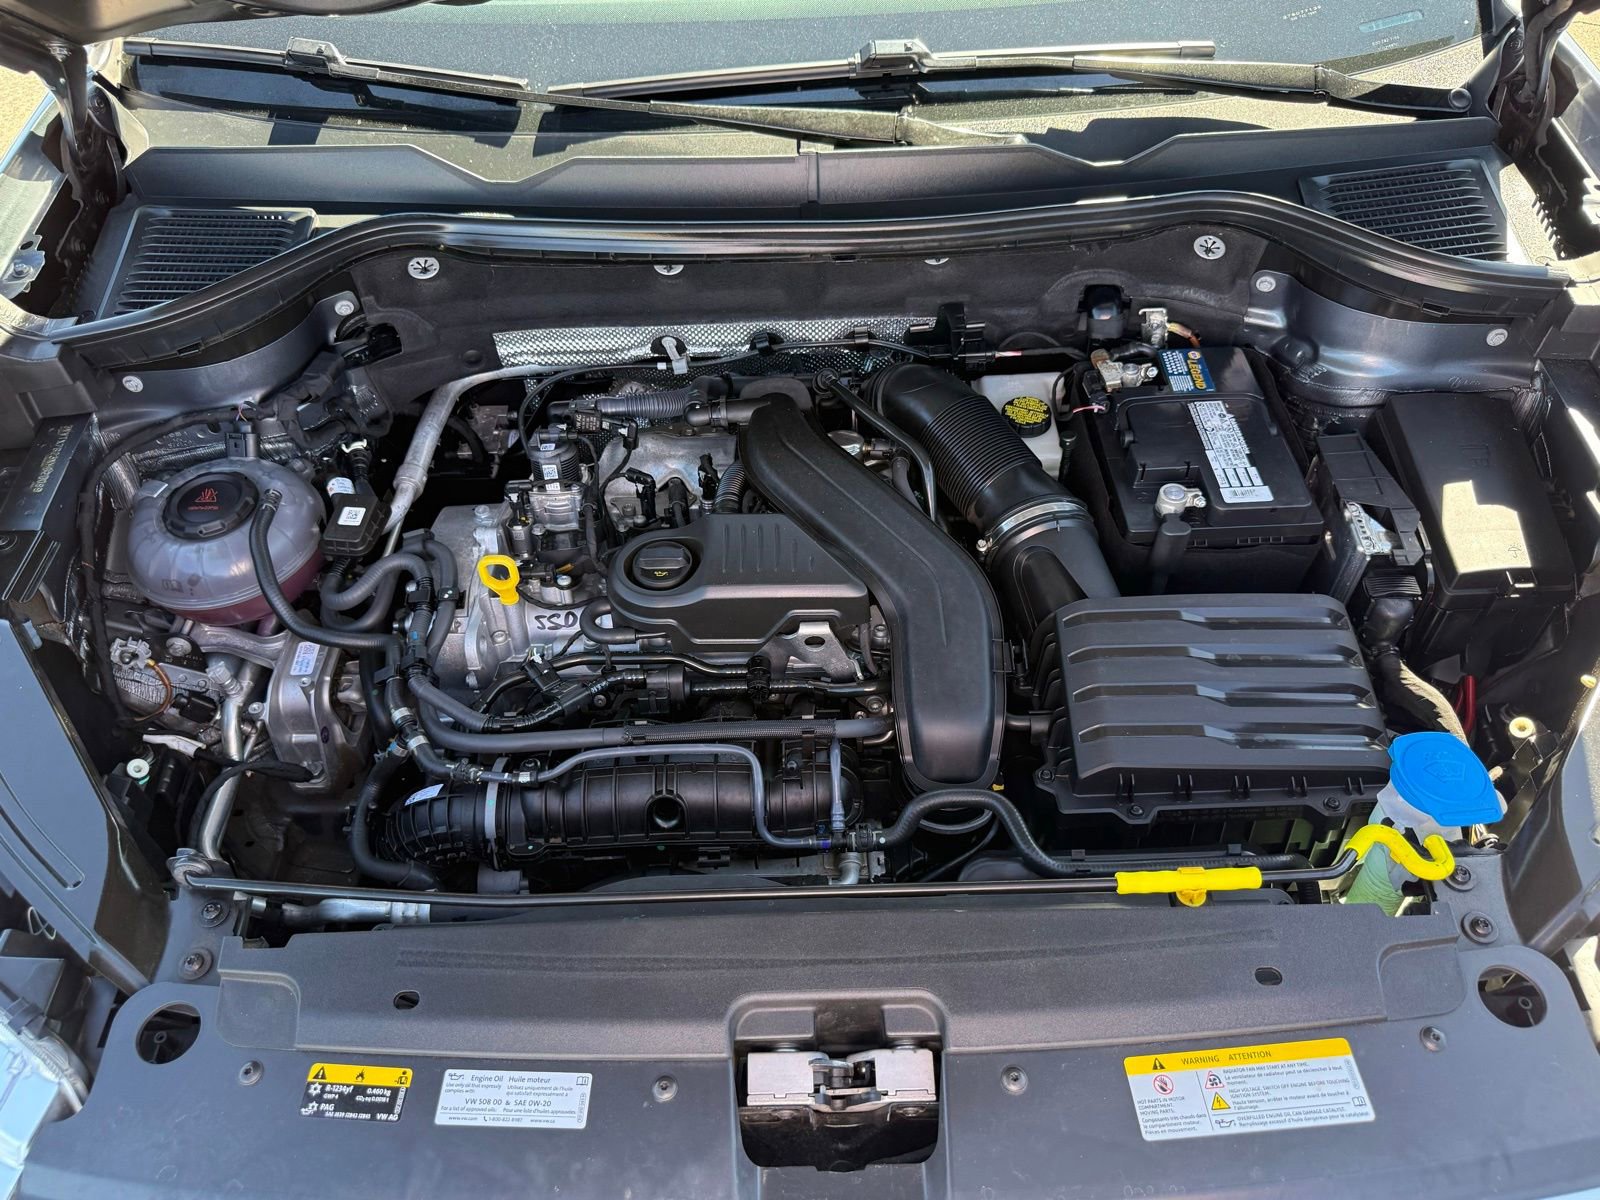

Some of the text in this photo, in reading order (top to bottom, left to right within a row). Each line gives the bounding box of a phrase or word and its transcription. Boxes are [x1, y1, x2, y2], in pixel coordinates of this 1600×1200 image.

[1187, 359, 1207, 390] LEGEND
[1181, 1050, 1271, 1065] WARNING ATTENTION
[470, 1075, 493, 1083] Engine
[508, 1075, 526, 1083] Huile
[325, 1084, 354, 1095] R-1234yf
[383, 1089, 392, 1097] kg
[320, 1103, 335, 1111] PAG
